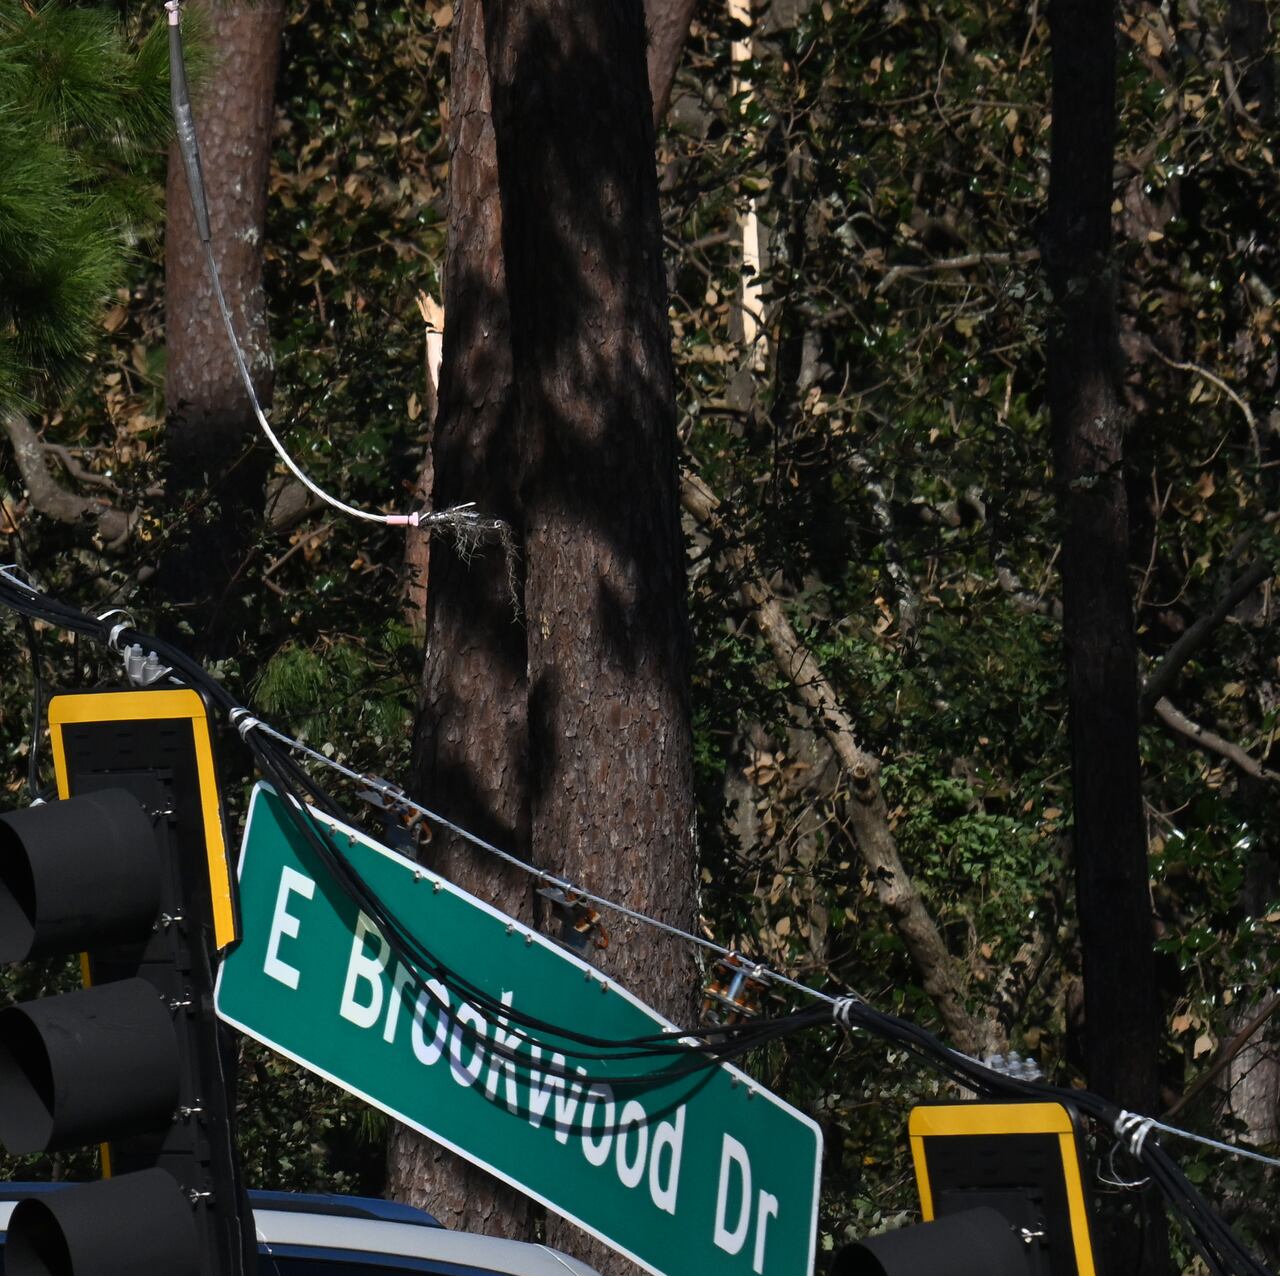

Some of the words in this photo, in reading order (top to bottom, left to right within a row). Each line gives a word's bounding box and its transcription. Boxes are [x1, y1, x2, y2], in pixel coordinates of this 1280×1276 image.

[263, 865, 316, 990] E
[339, 908, 687, 1216] Brookwood
[713, 1132, 779, 1275] Dr
